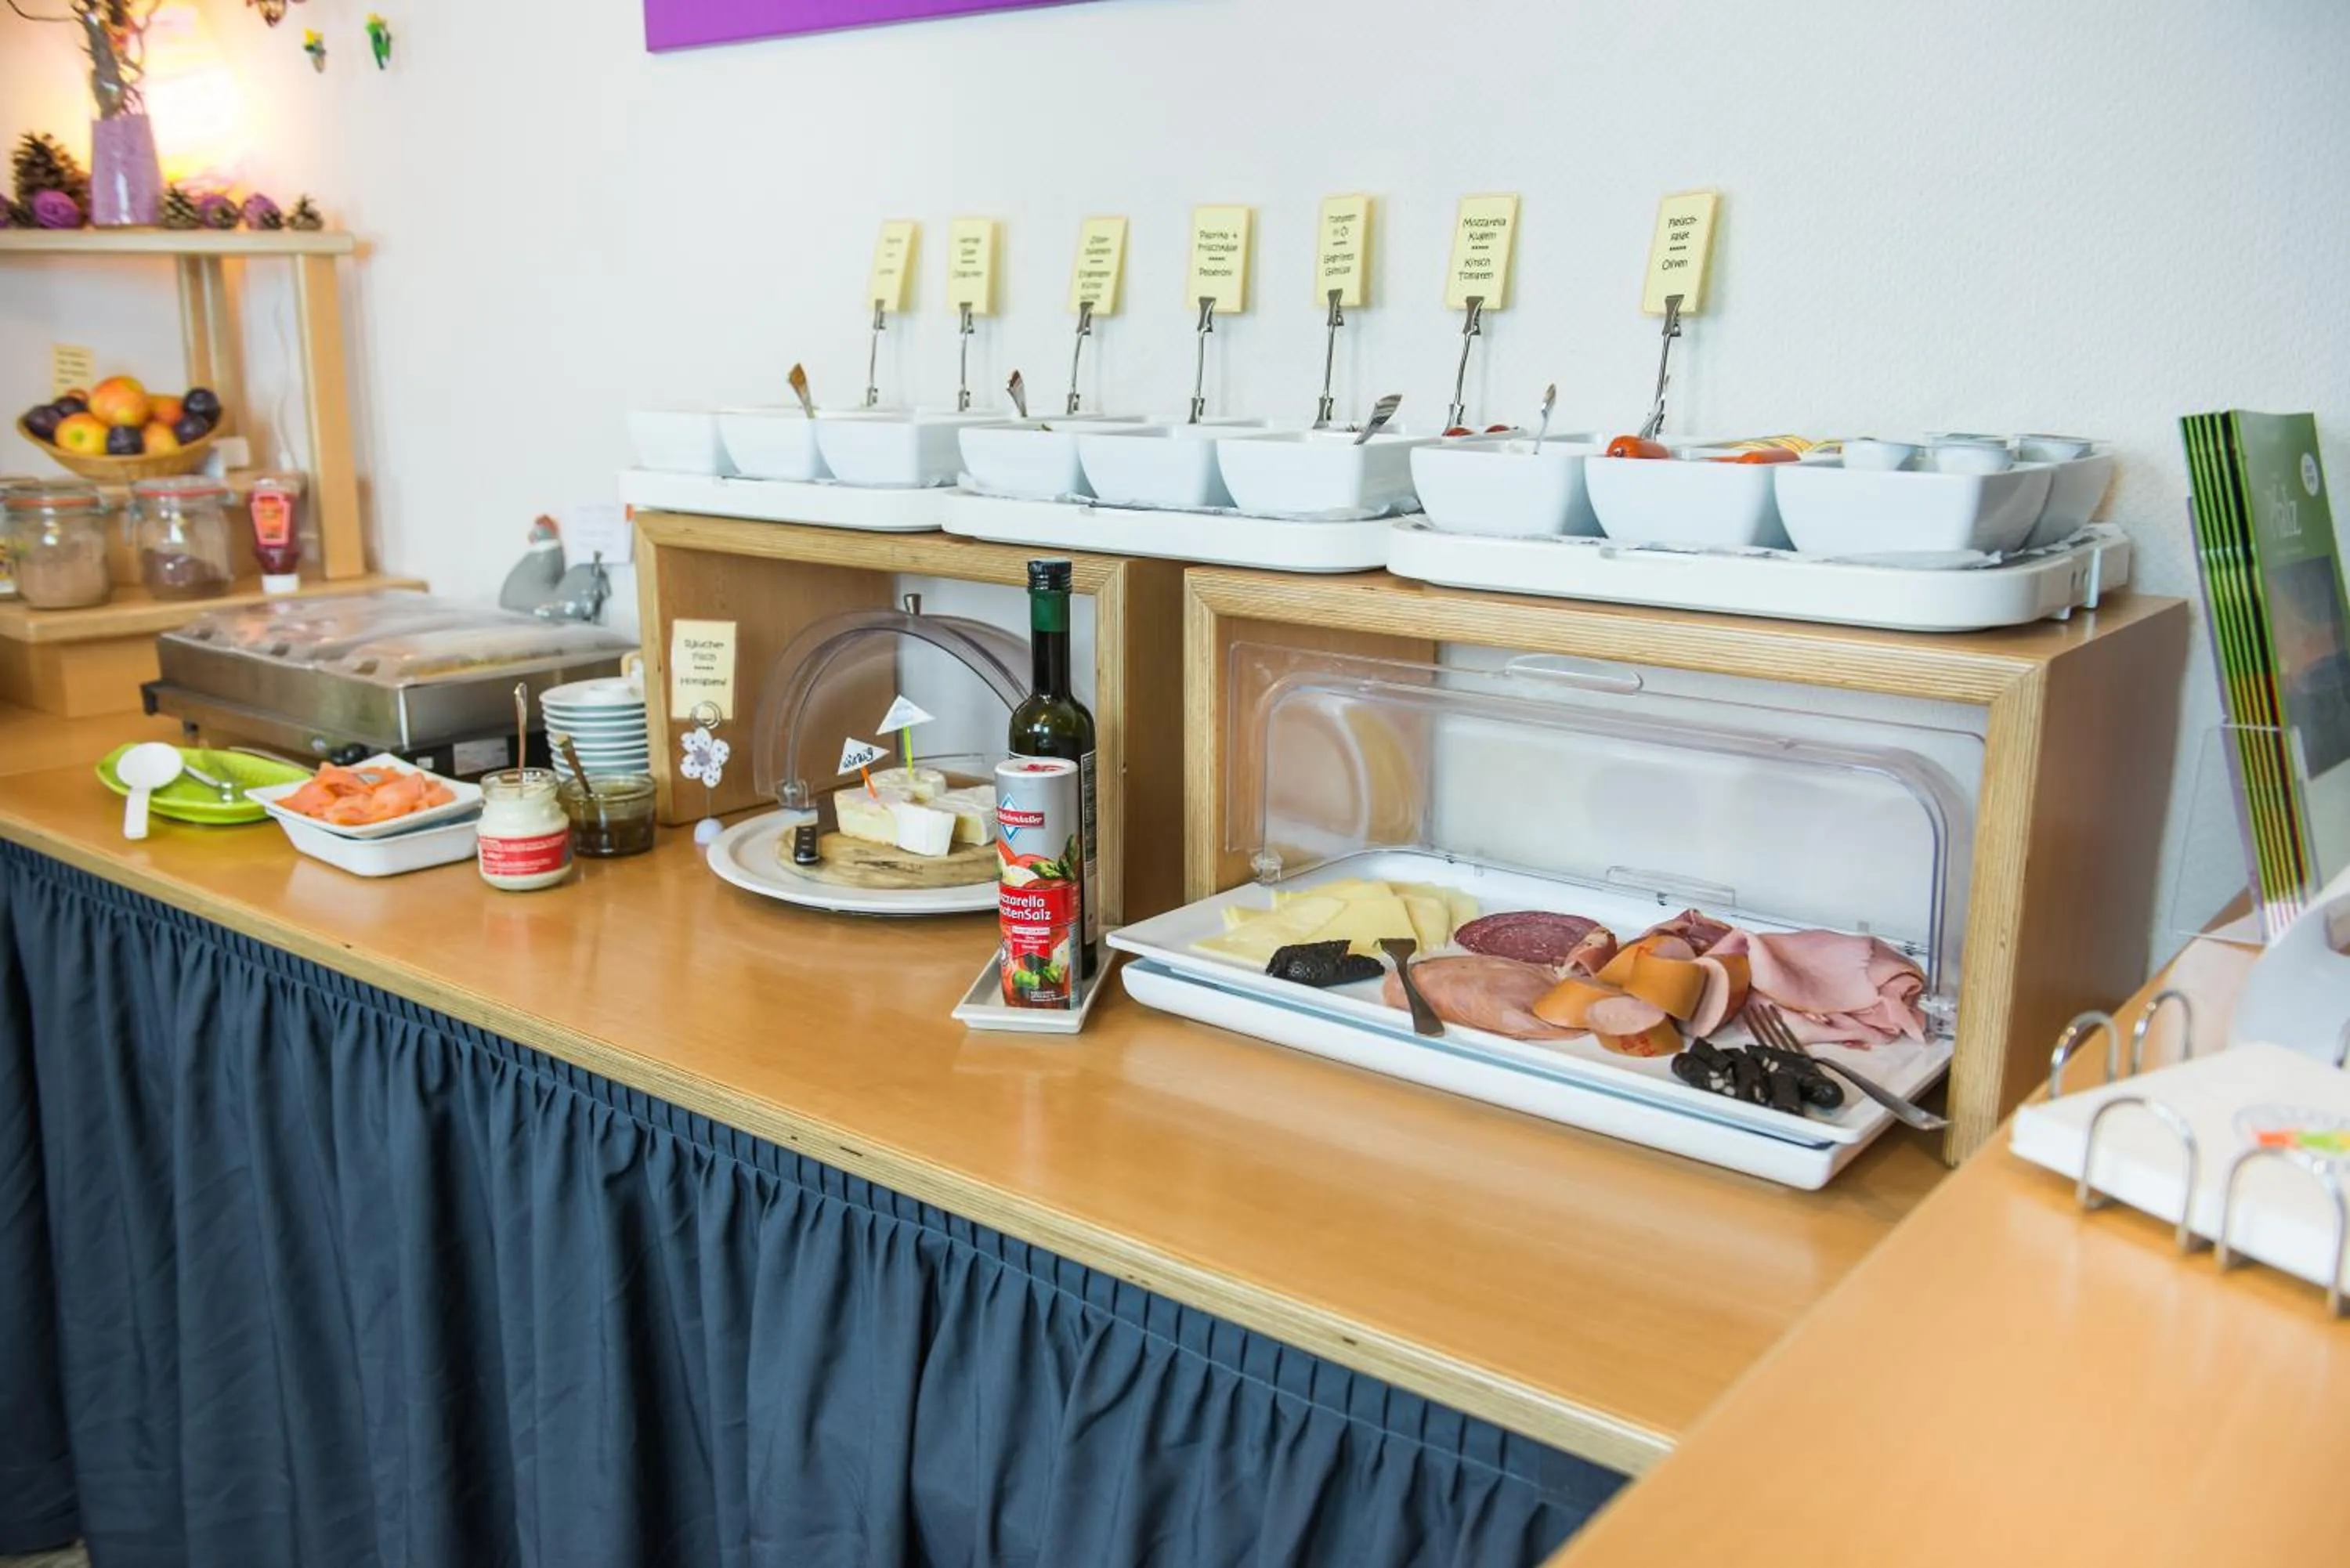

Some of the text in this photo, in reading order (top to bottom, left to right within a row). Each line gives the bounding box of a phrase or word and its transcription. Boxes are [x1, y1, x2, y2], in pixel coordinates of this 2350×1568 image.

[1462, 218, 1506, 227] Mozzarella
[1661, 258, 1688, 270] Oliven
[1459, 271, 1494, 281] Tomaten
